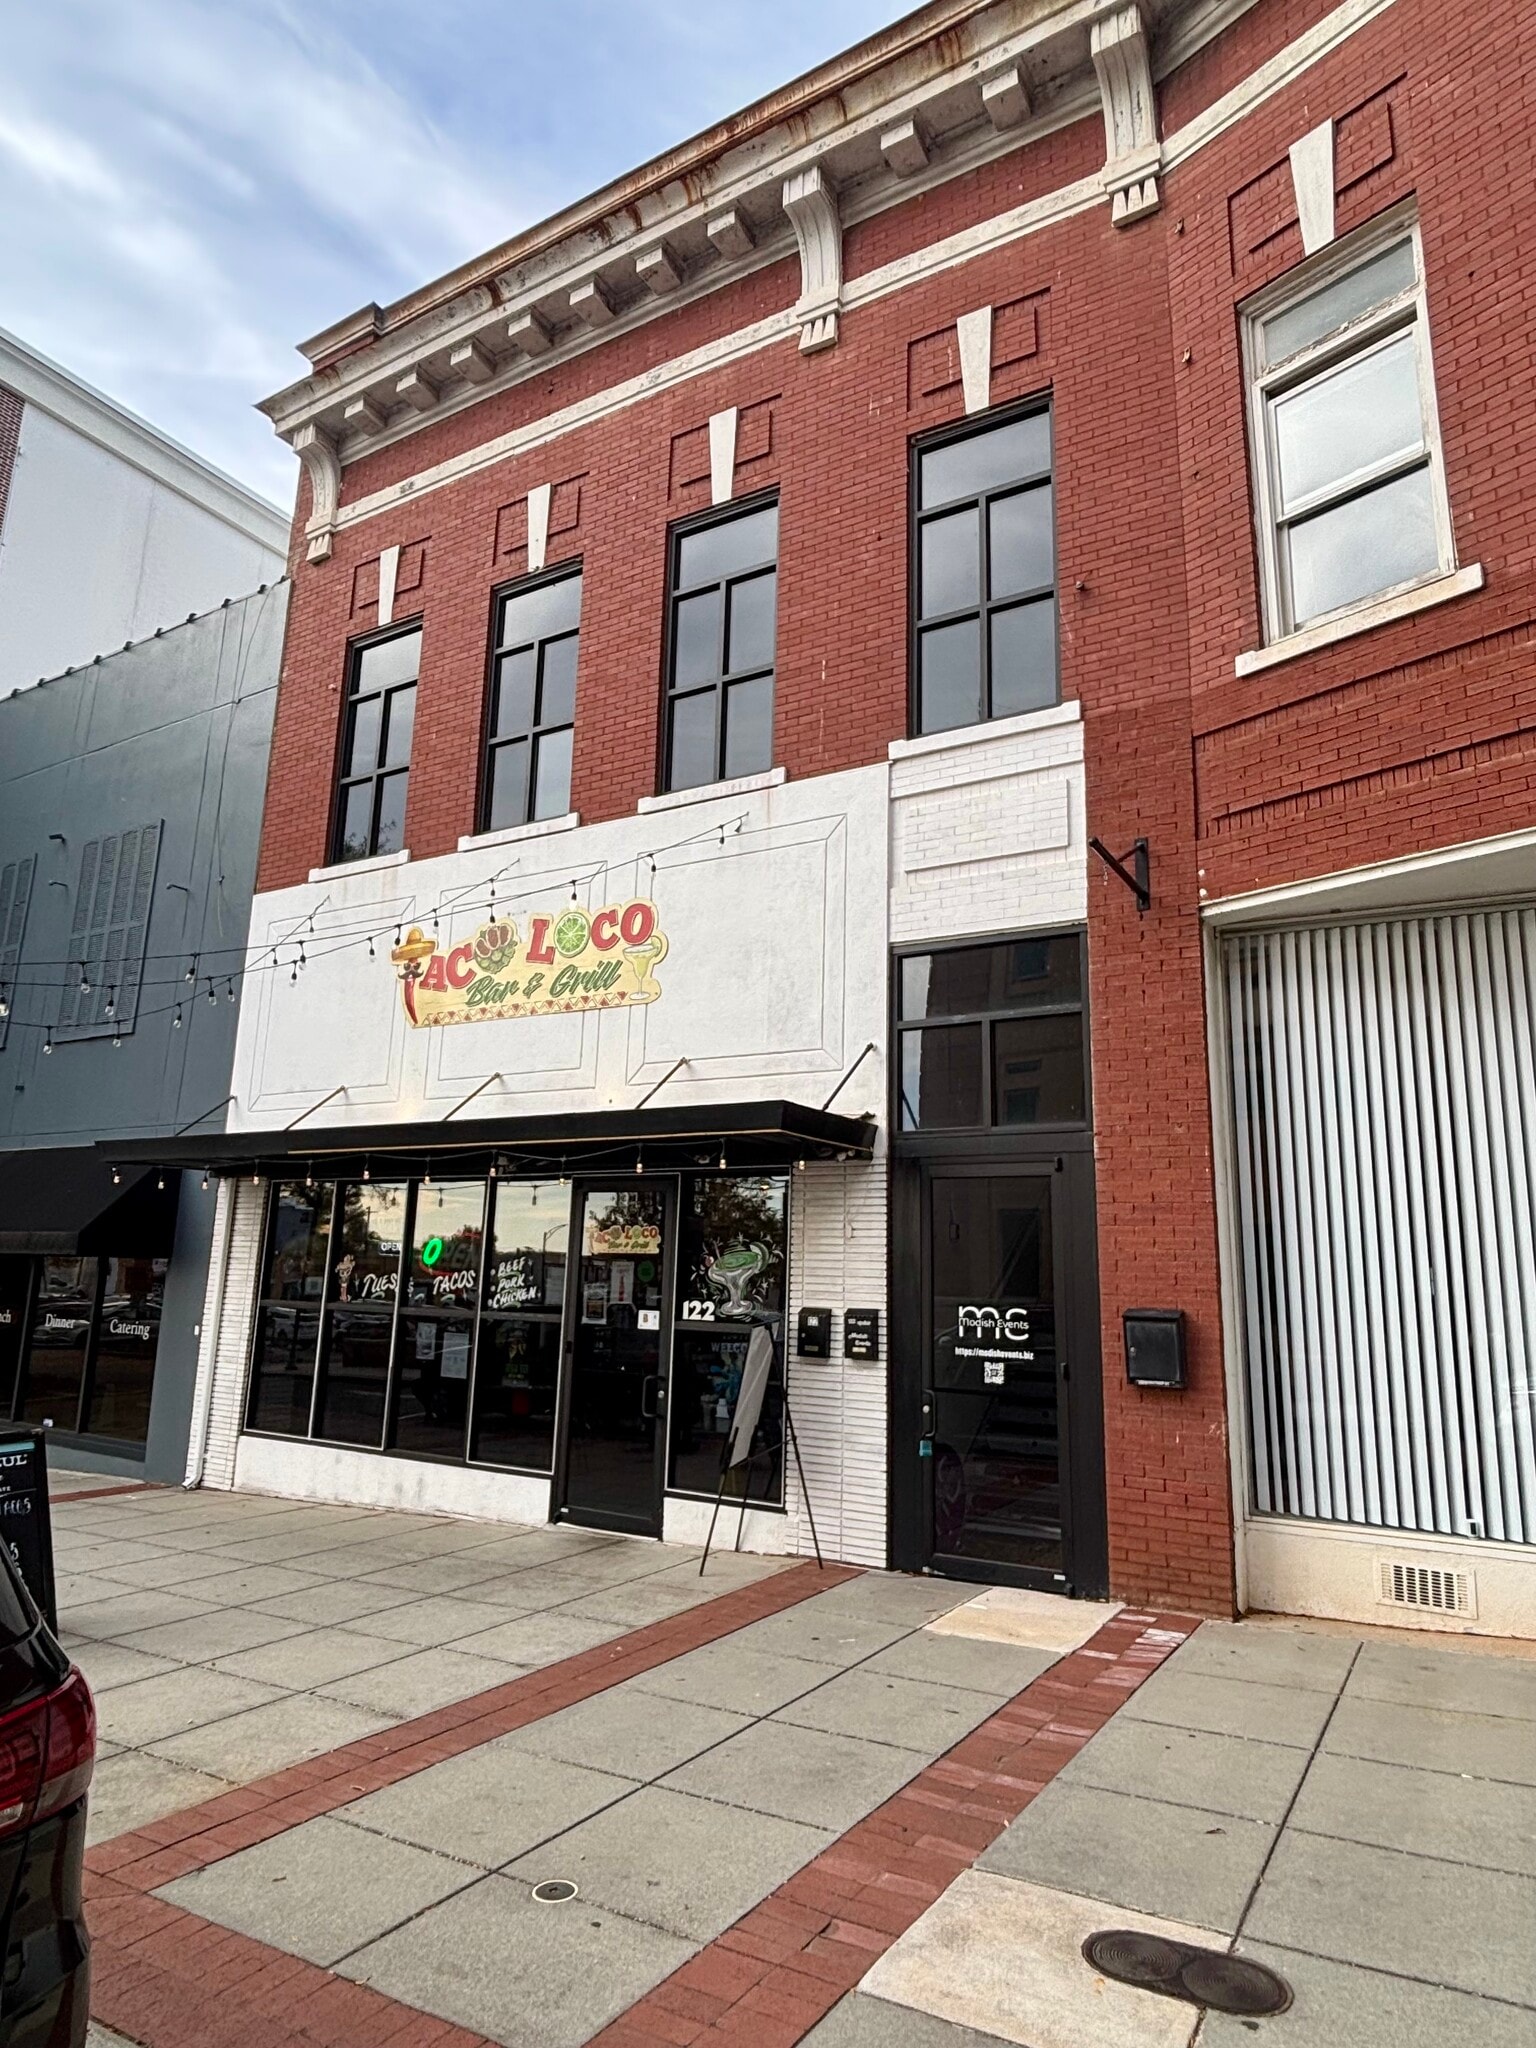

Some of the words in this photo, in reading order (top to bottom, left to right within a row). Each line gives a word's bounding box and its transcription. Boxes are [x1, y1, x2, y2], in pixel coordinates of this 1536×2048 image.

[525, 903, 655, 965] LOCO
[465, 975, 519, 1007] Bar
[522, 972, 545, 998] &
[549, 959, 623, 998] Grill
[497, 1256, 526, 1277] BEEF
[432, 1269, 476, 1296] TACOS
[497, 1273, 525, 1292] PORK
[492, 1286, 537, 1308] CHICKEN
[44, 1313, 76, 1329] Dinner
[682, 1299, 716, 1322] 122
[109, 1318, 151, 1340] Catering
[959, 1317, 995, 1328] Modish
[996, 1319, 1030, 1330] Events
